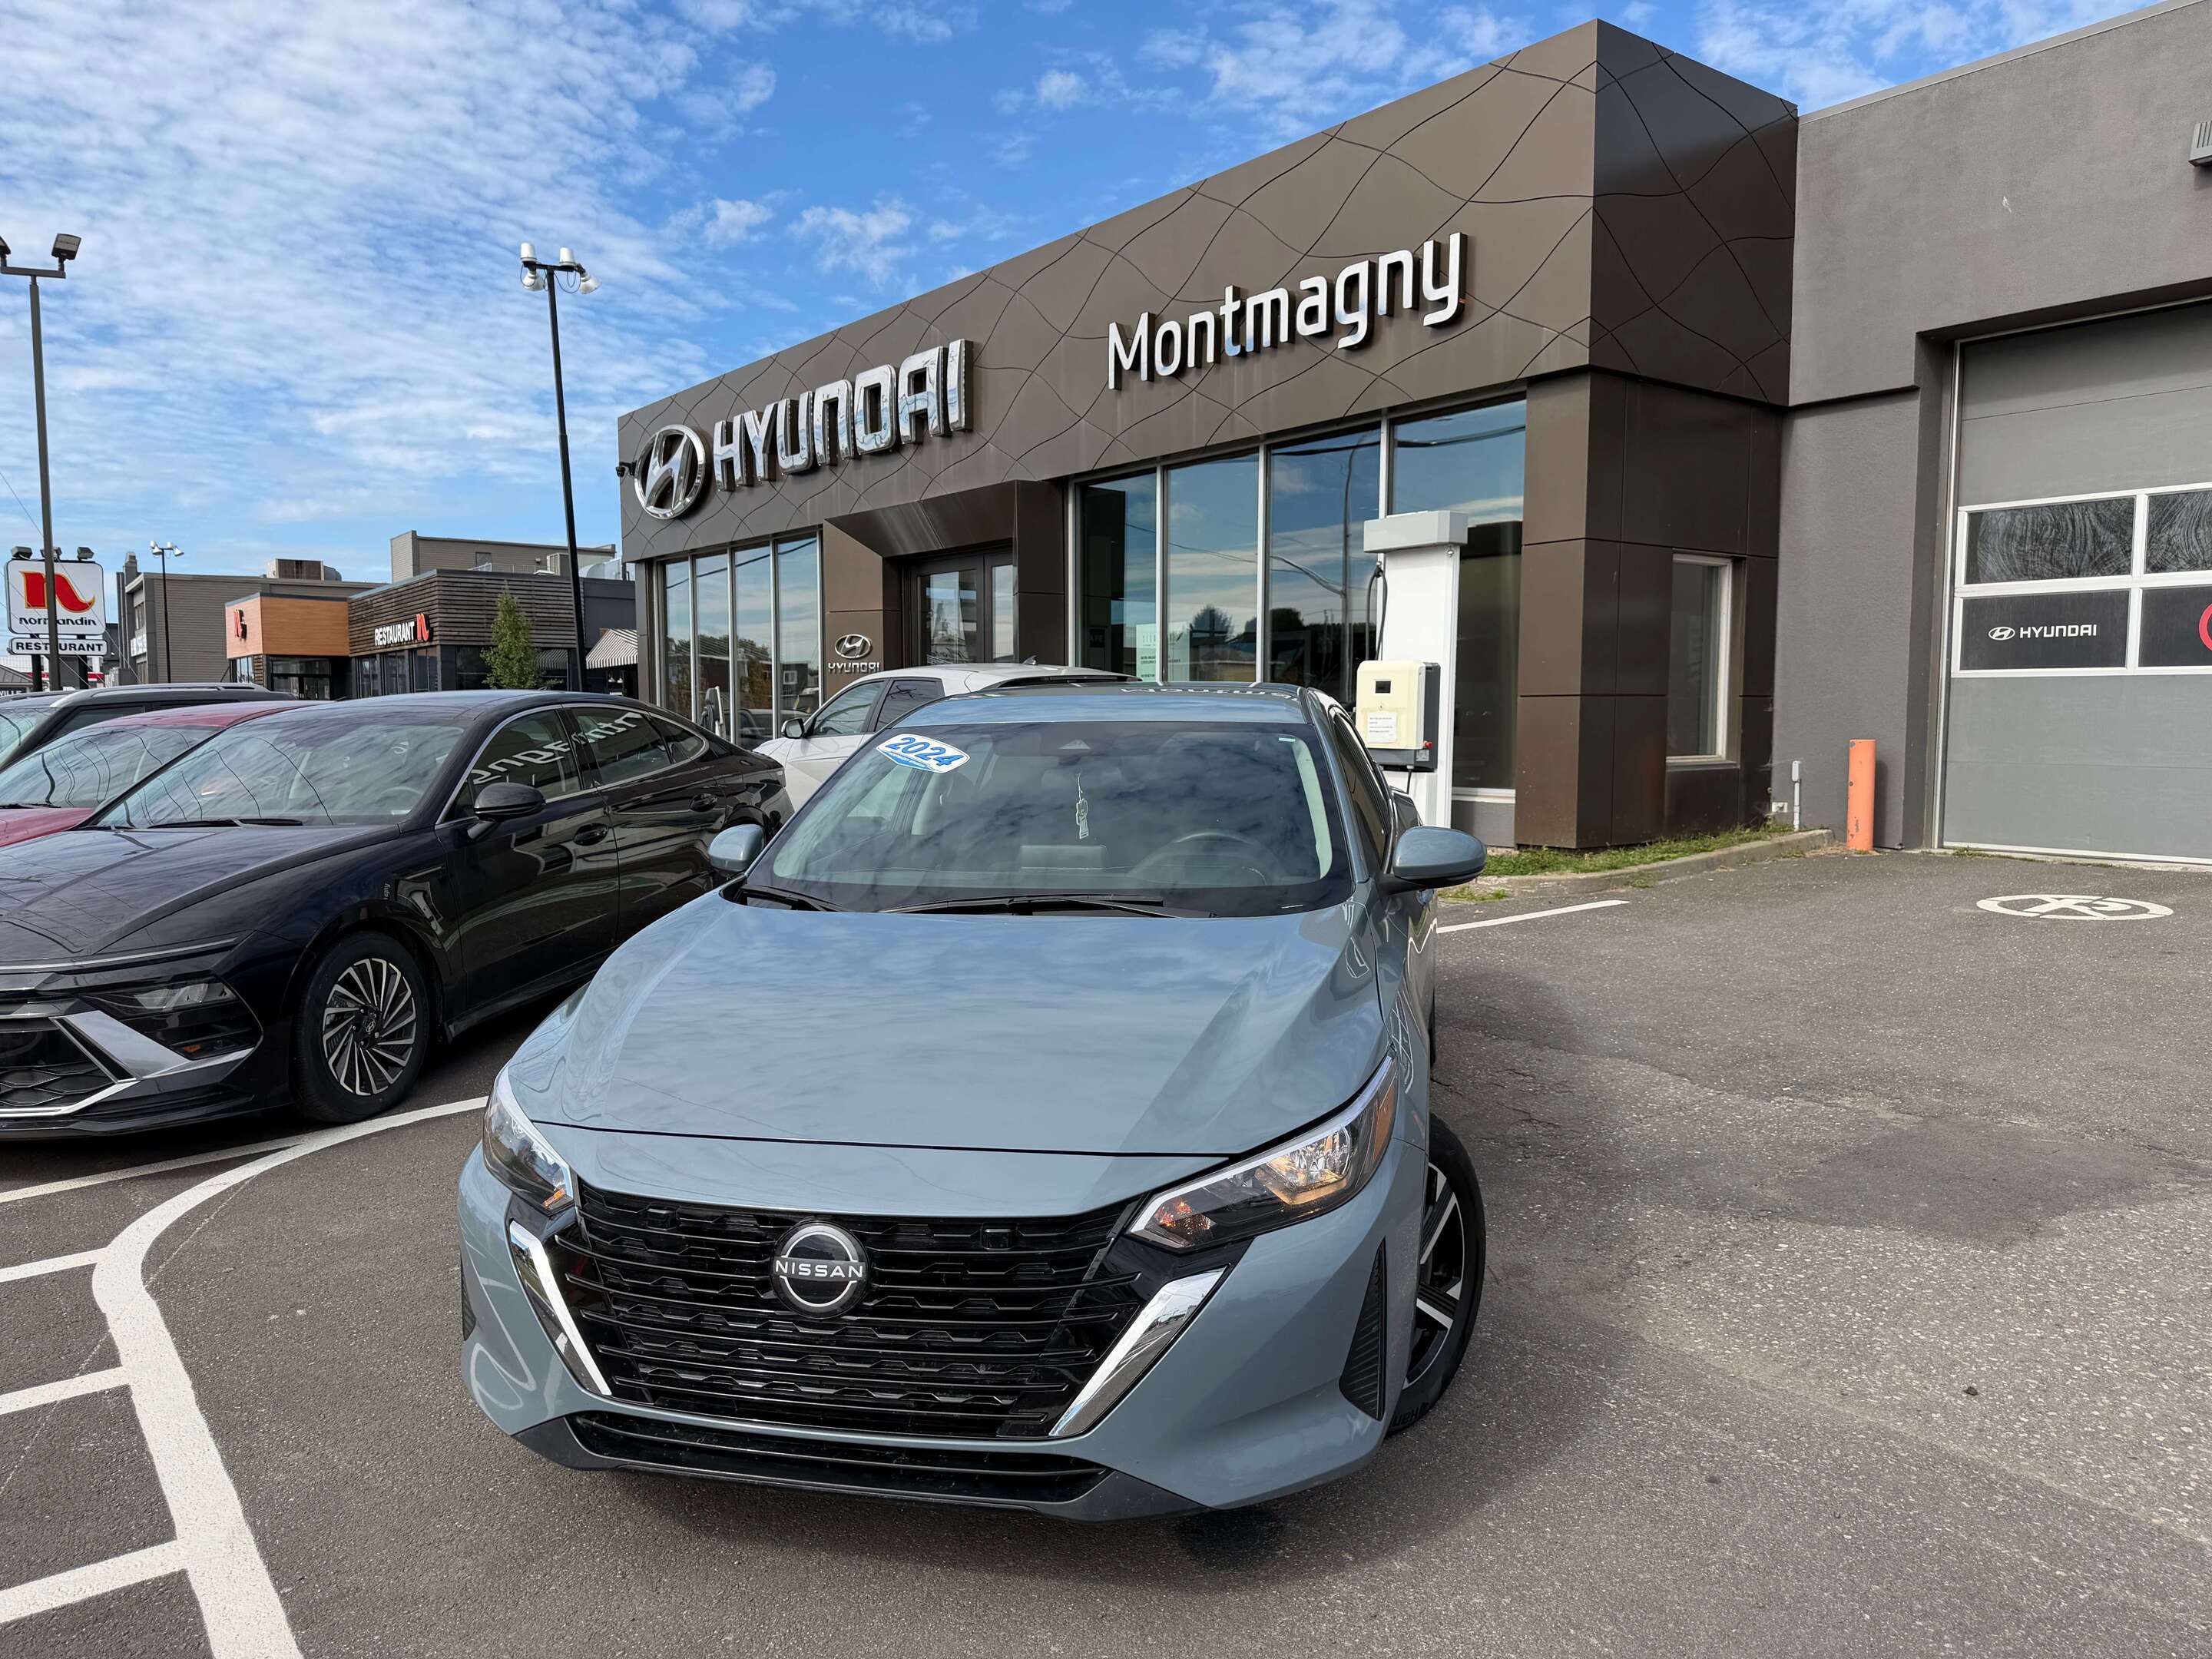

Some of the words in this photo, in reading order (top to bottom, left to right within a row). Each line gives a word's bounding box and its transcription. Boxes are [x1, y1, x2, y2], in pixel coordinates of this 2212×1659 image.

[1108, 232, 1463, 389] Montmagny
[713, 339, 971, 492] HYUNDAI
[374, 621, 415, 646] RESTAURANT
[2019, 624, 2098, 639] HYUNDAI
[15, 641, 104, 651] RESTURANT
[828, 661, 880, 674] HYUNDAI
[885, 737, 965, 767] 2024
[775, 1260, 863, 1278] NISSAN
